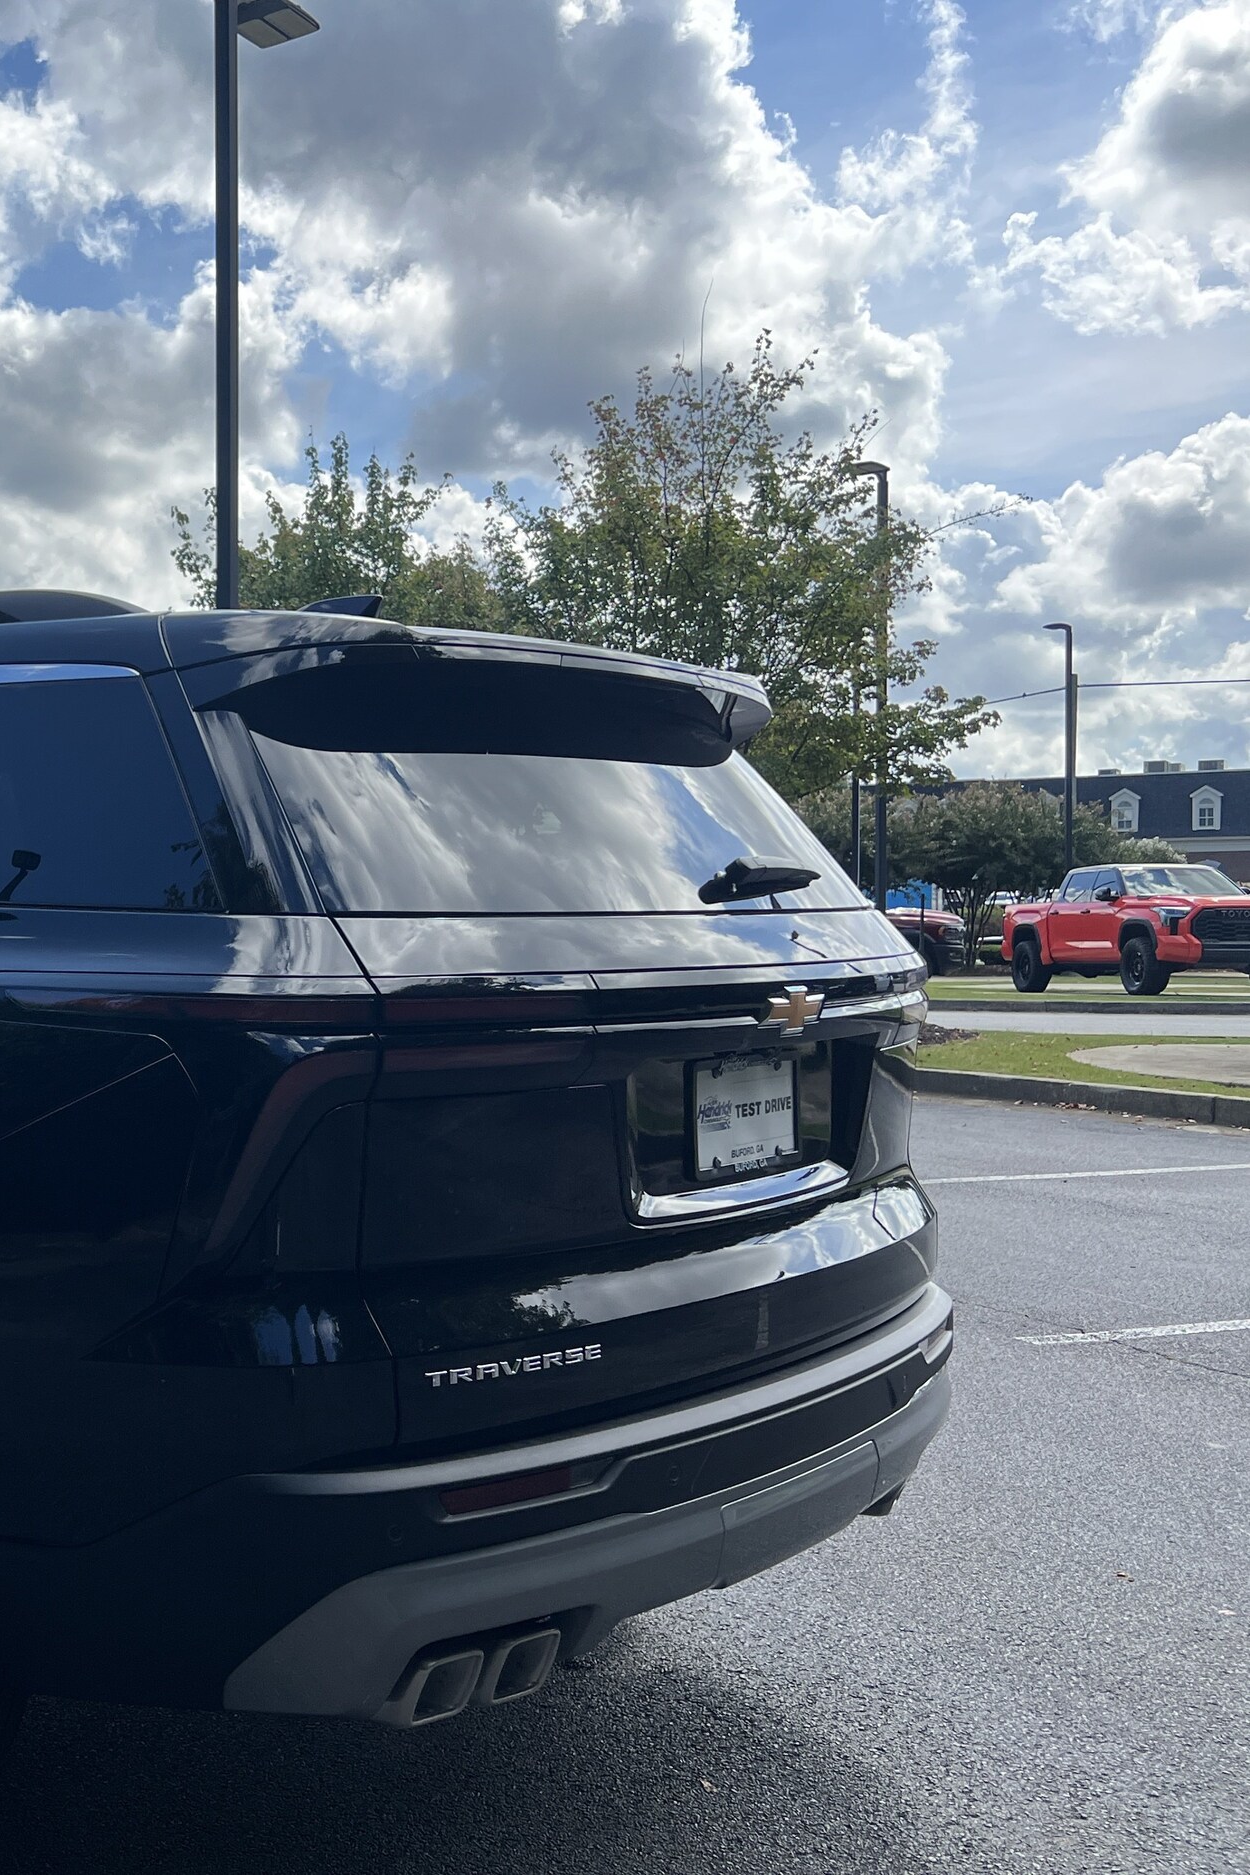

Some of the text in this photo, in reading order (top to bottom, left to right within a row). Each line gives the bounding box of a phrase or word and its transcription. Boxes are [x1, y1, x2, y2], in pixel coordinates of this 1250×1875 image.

[734, 1095, 792, 1119] TEST DRIVE
[424, 1343, 602, 1387] TRAVERSE
